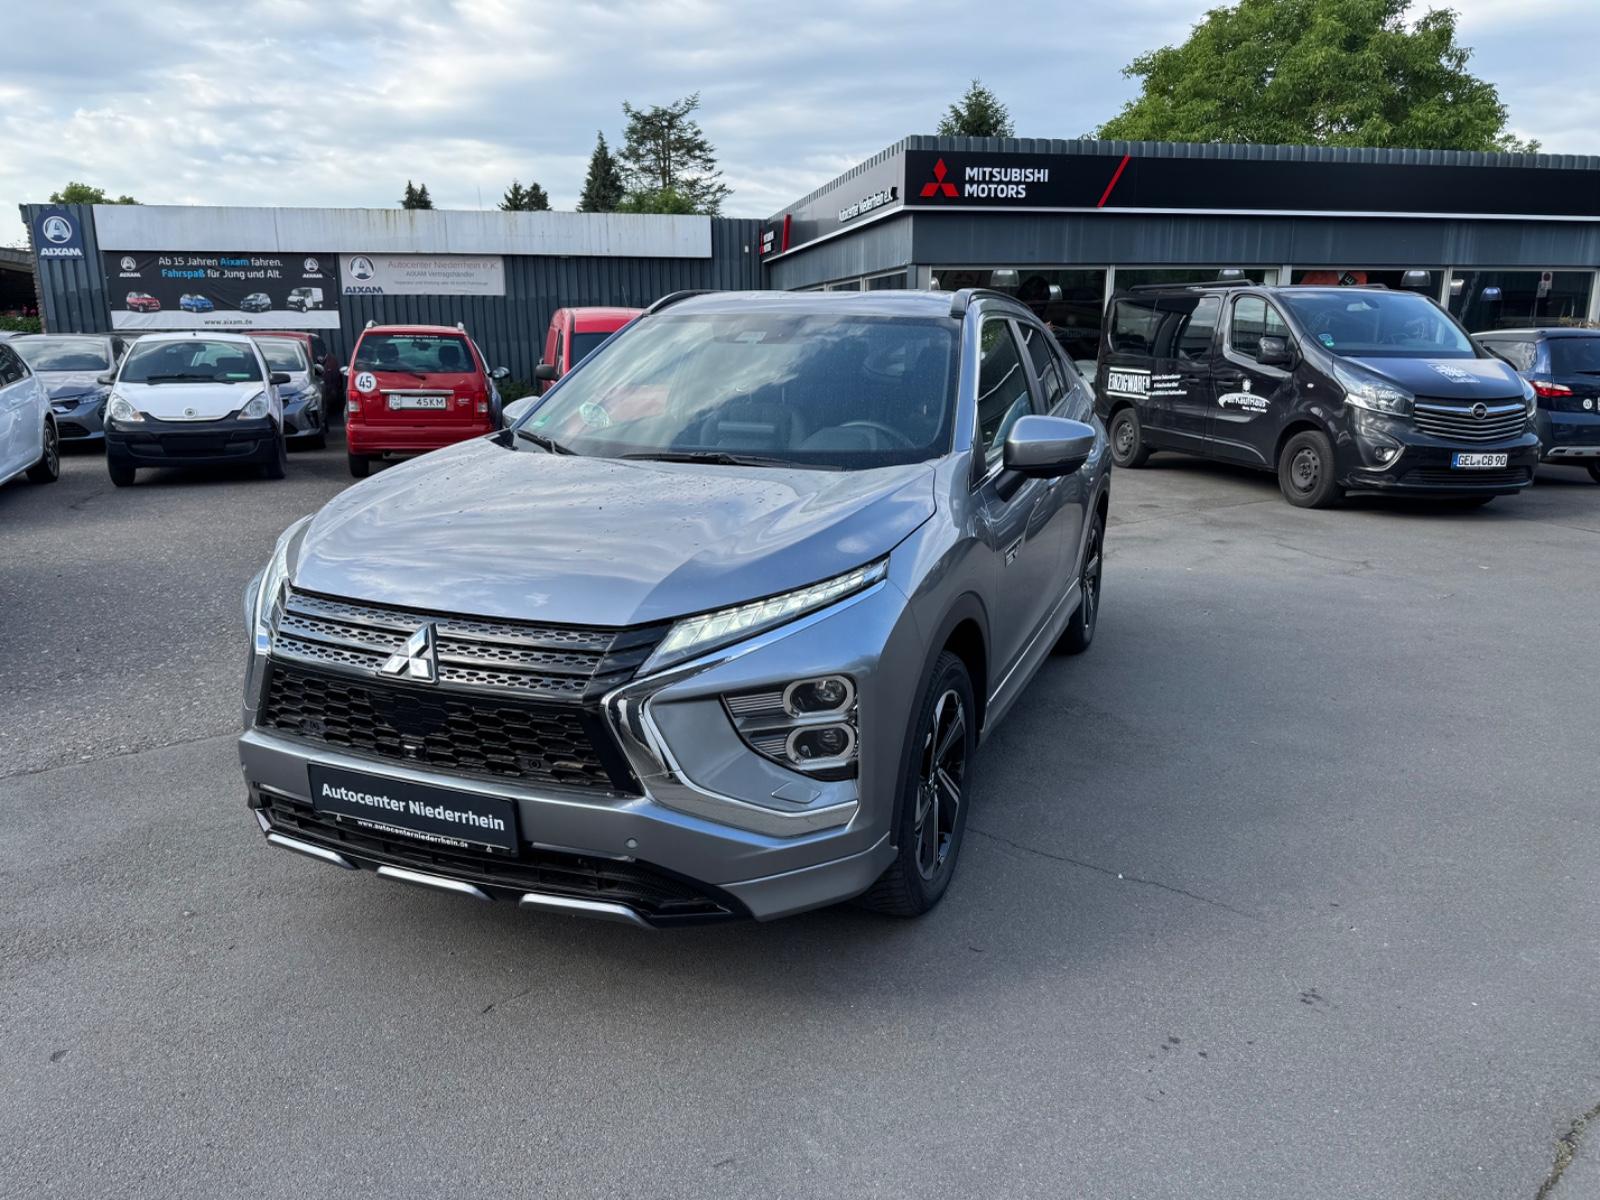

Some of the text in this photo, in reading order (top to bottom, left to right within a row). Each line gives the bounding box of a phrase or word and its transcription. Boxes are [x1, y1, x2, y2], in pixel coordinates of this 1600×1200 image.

[964, 167, 1049, 183] MITSUBISHI
[964, 184, 1027, 199] MOTORS
[40, 247, 83, 256] AIXAM
[158, 257, 284, 267] Ab 15 Jahren Aixam fahren.
[387, 260, 432, 269] Autocenter
[433, 261, 481, 269] Niederrhein
[161, 268, 283, 280] Fahrspaß für Jung und Alt.
[344, 286, 384, 294] AIXAM
[359, 376, 372, 389] 45
[416, 398, 444, 407] 45KM
[1458, 455, 1507, 466] GEL CB 90
[321, 783, 505, 831] Autocenter Niederrhein
[356, 819, 469, 848] www.autocenterniederrhein.de
